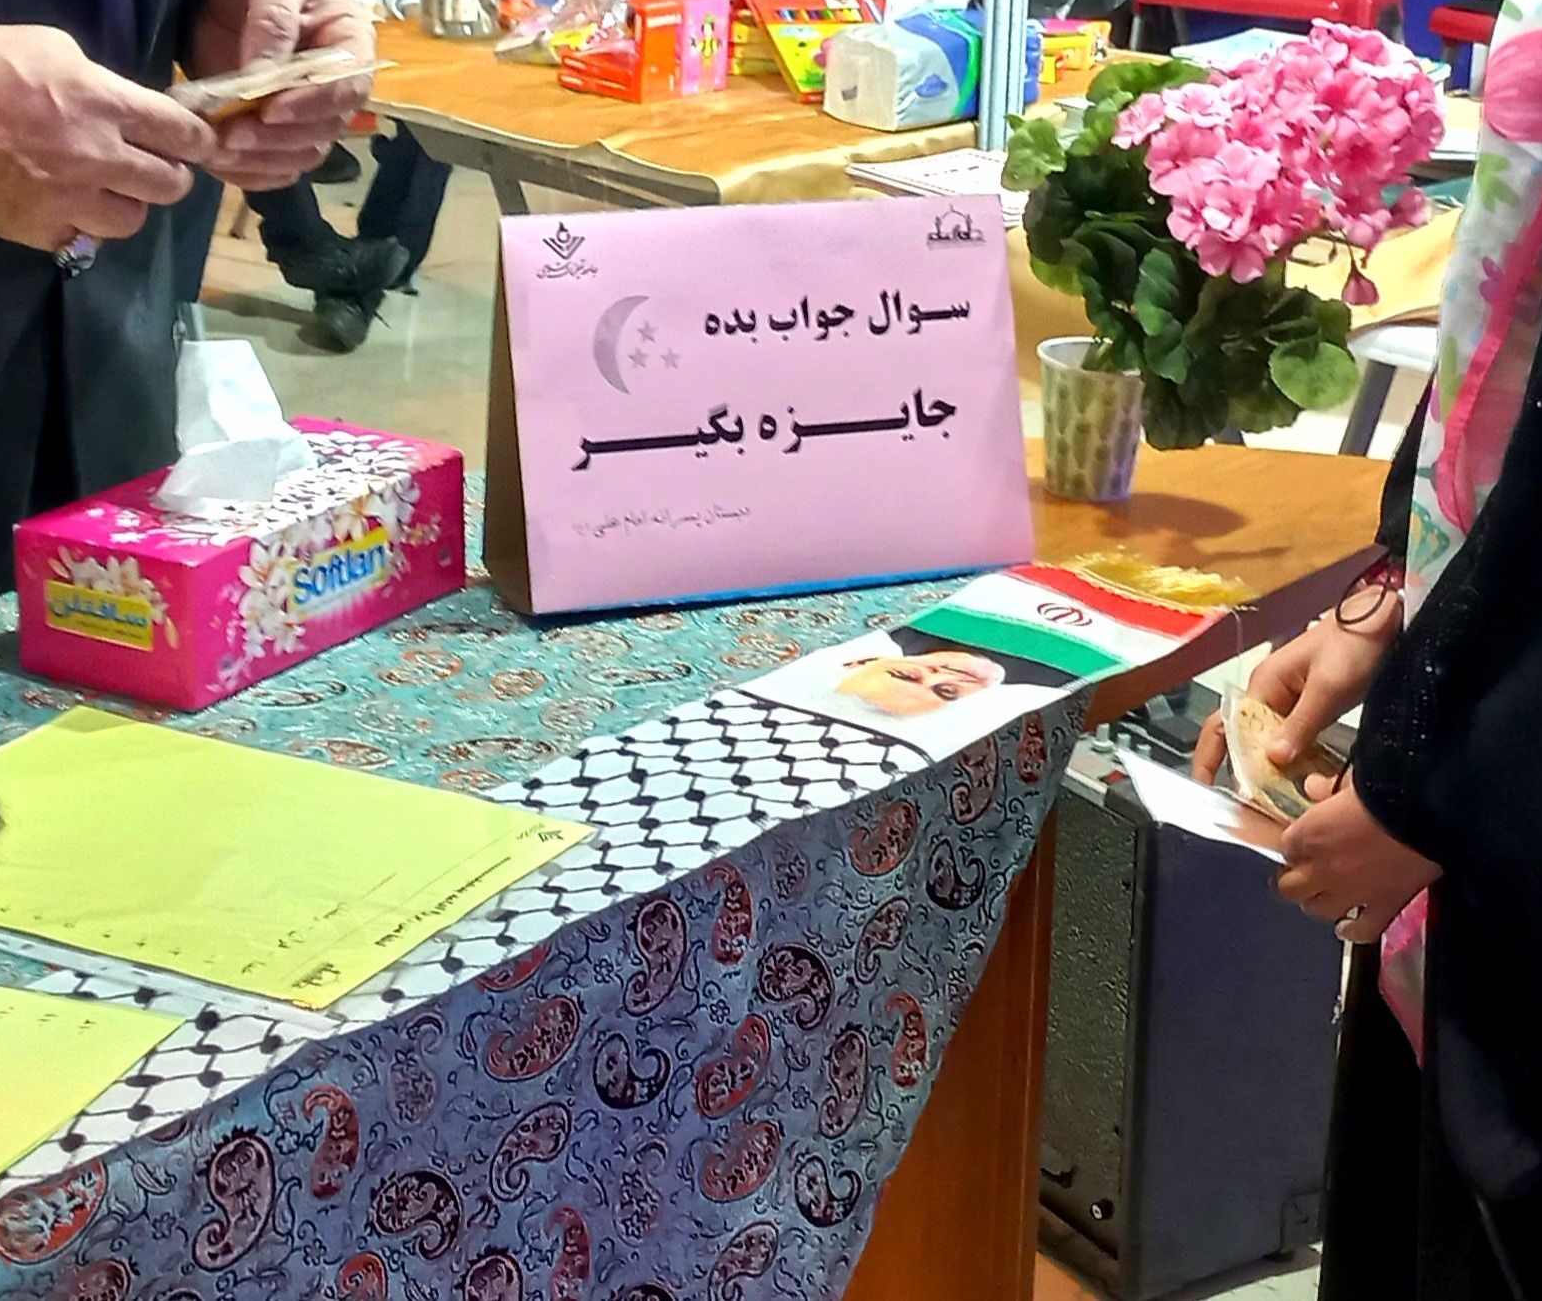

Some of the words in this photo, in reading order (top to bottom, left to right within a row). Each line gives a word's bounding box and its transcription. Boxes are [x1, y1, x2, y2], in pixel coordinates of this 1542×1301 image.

[704, 307, 758, 344] بده
[768, 296, 856, 342] جواب
[868, 288, 971, 336] سوال
[570, 402, 746, 473] بگیر
[758, 386, 958, 456] جایزه
[291, 544, 388, 606] Softlan
